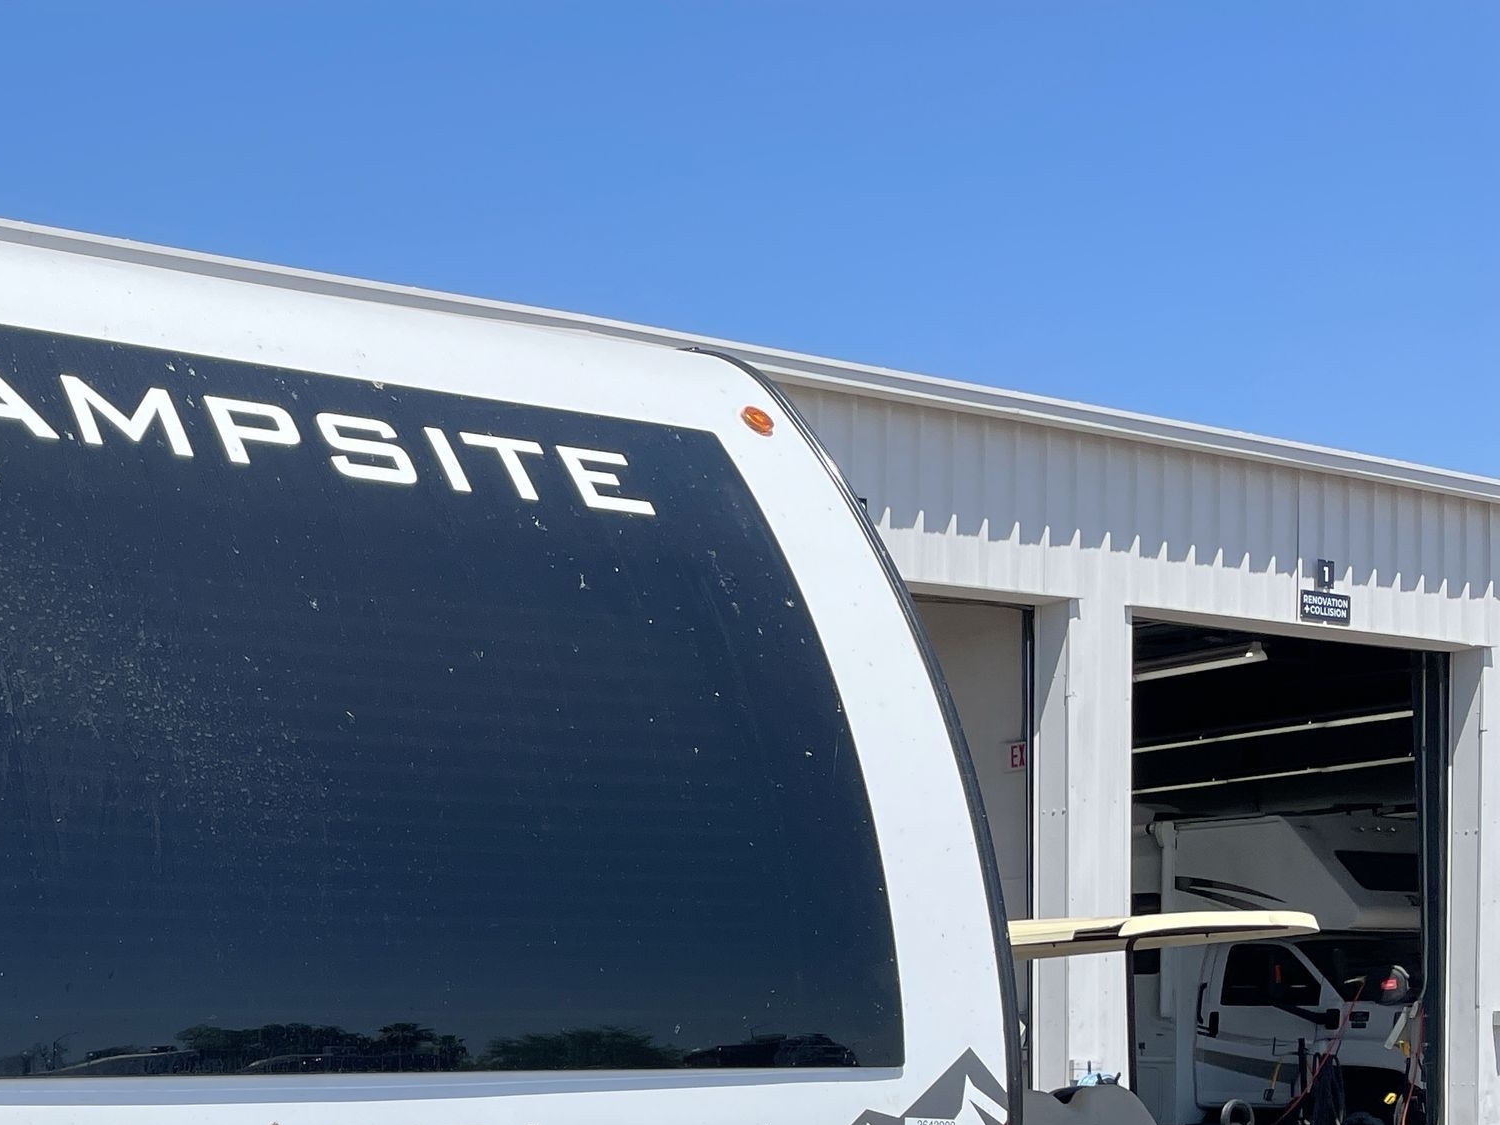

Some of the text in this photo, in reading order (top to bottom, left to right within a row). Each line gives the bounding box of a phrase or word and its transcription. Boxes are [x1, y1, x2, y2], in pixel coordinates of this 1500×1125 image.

[1324, 566, 1328, 582] 1
[1303, 594, 1348, 609] RENOVATION
[1304, 604, 1347, 618] +COLLISION
[1011, 743, 1025, 768] EX
